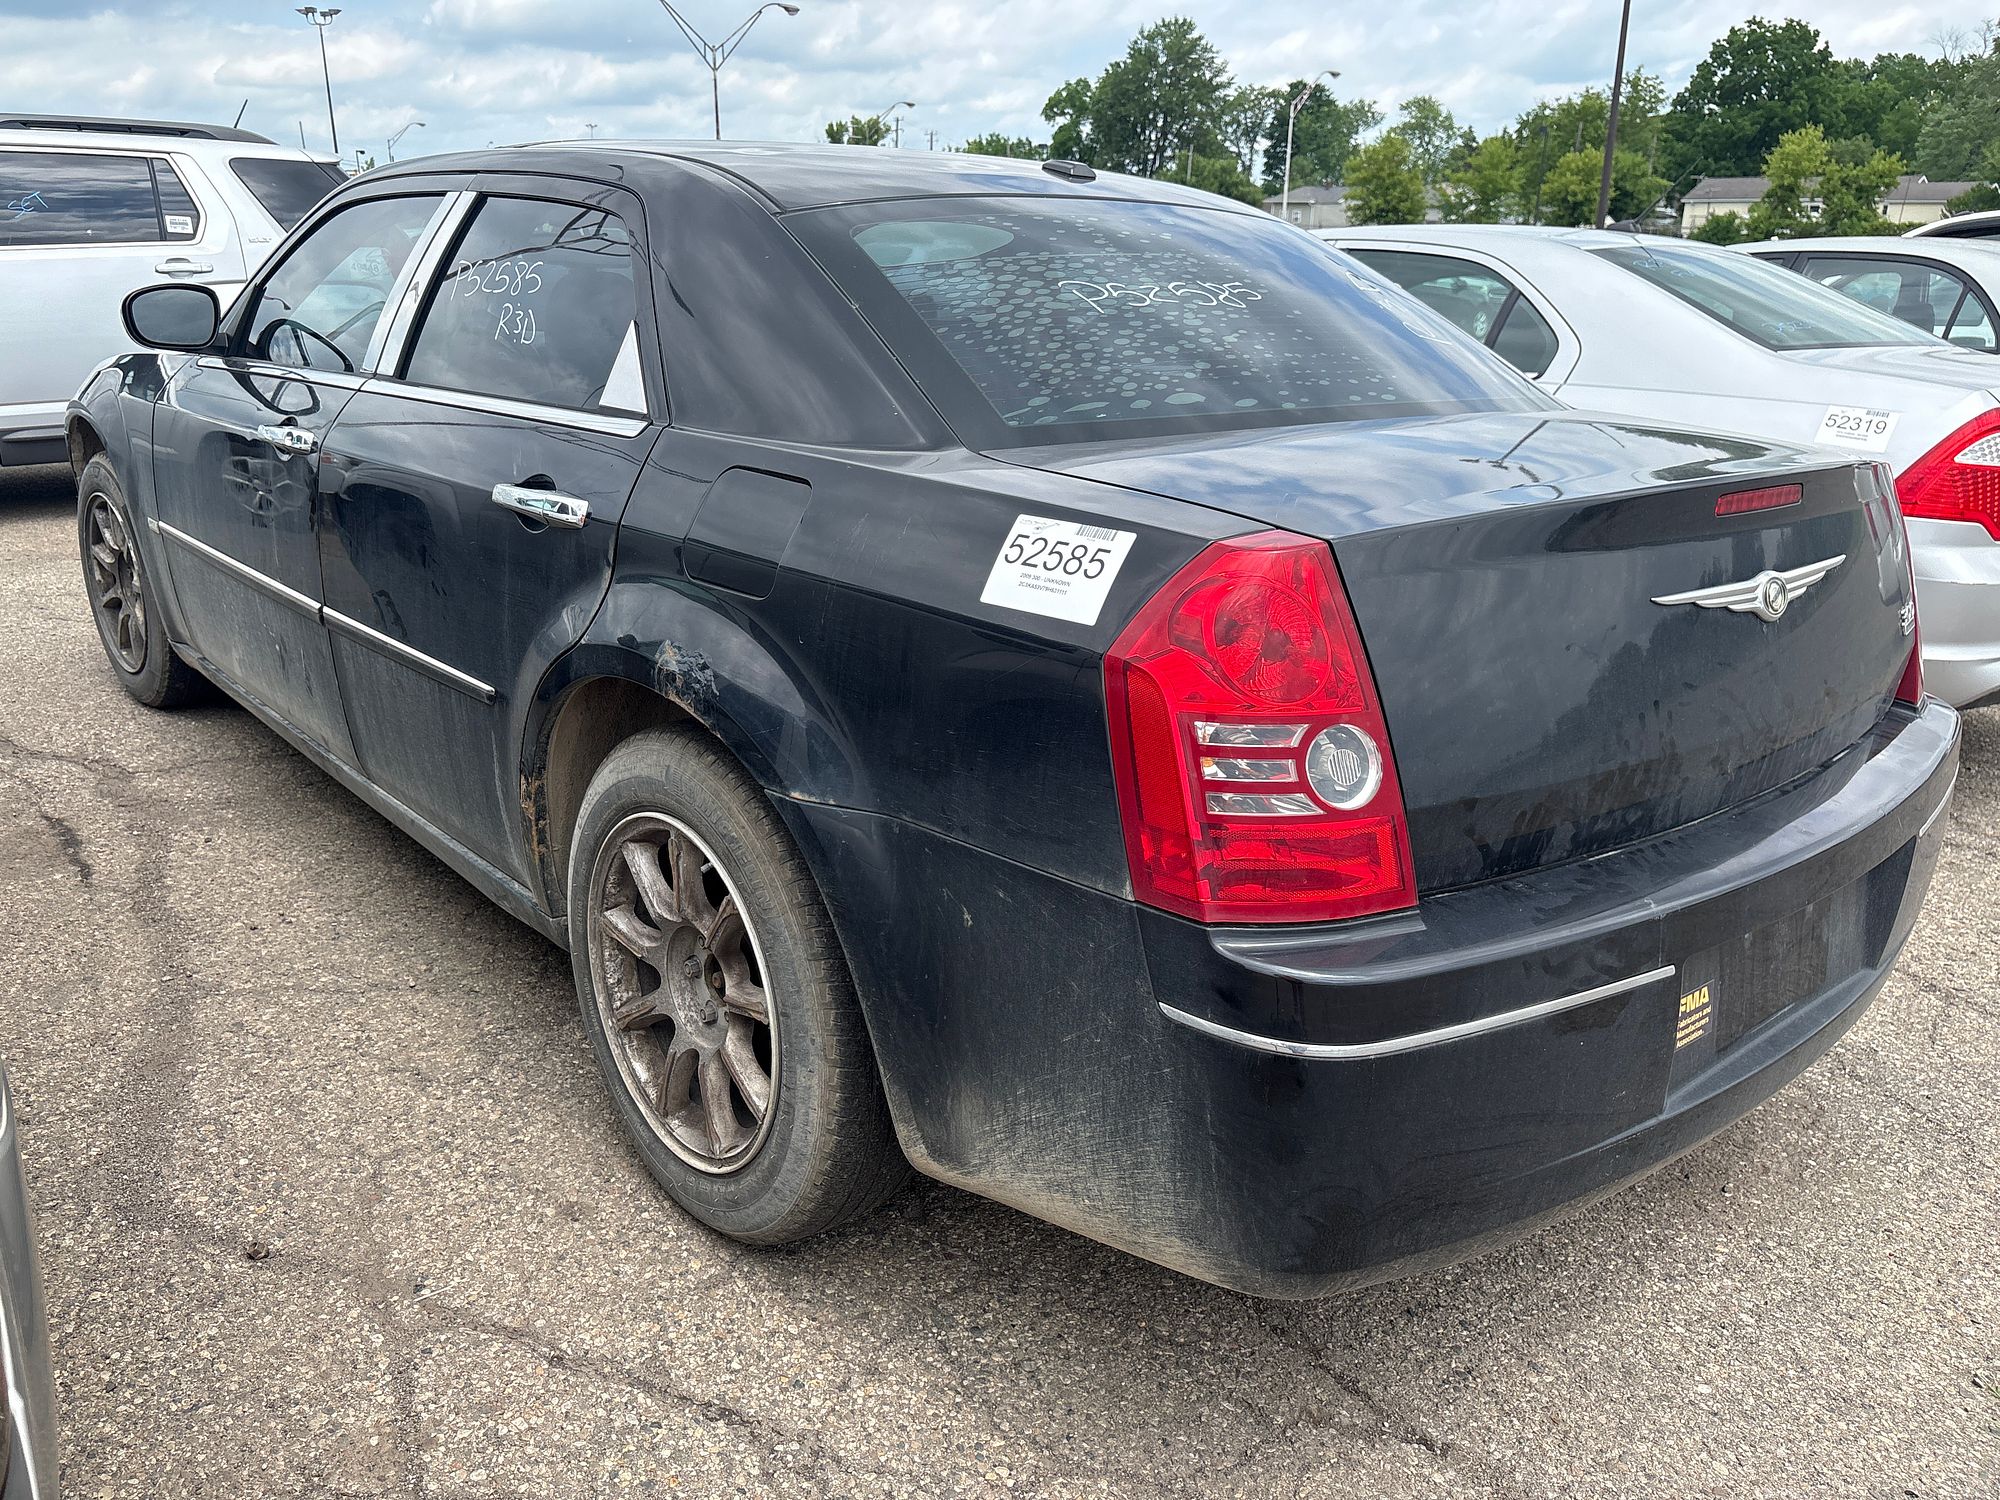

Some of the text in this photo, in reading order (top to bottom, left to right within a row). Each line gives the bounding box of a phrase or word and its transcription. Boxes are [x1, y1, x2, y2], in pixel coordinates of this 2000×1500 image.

[450, 259, 544, 301] P52585
[1057, 280, 1262, 314] P52585
[1825, 413, 1887, 435] 52319
[1004, 533, 1112, 580] 52585
[1678, 985, 1710, 1017] FMA
